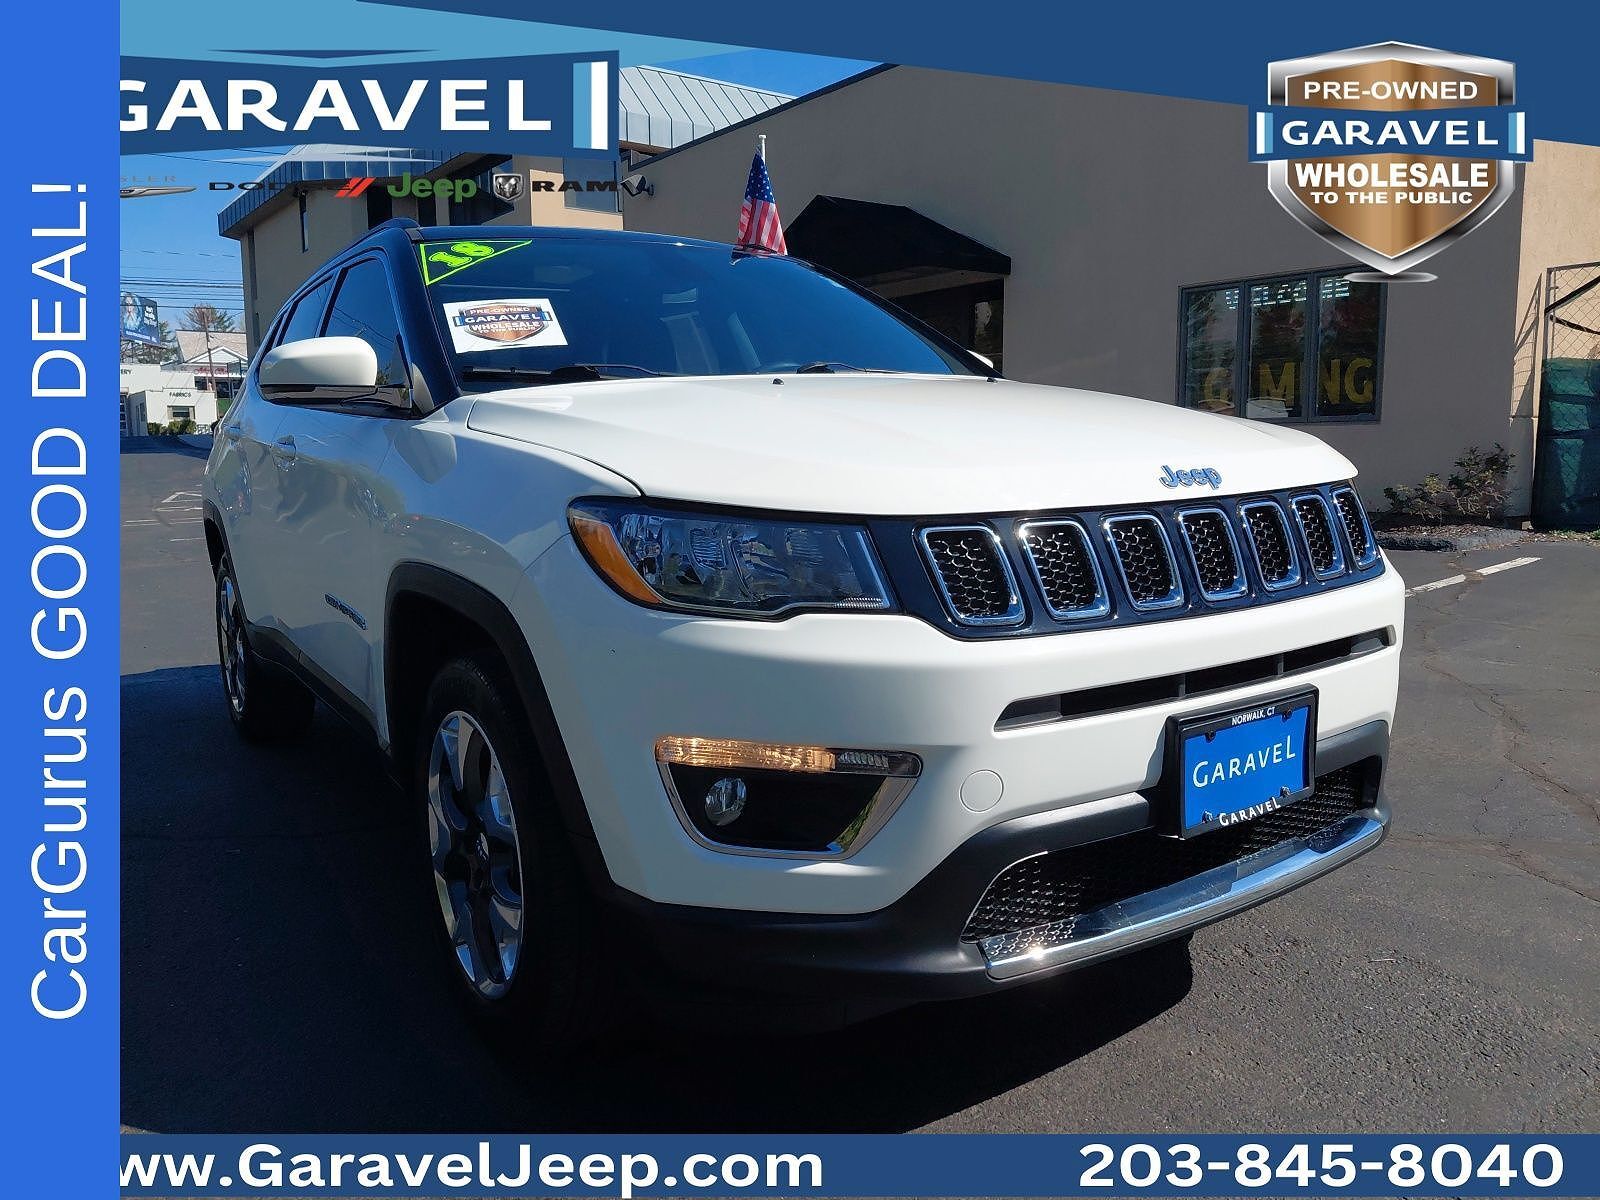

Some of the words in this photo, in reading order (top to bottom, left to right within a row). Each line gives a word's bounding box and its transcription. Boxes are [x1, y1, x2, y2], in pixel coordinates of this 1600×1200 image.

[464, 313, 541, 323] GARAVEL
[472, 321, 541, 331] WHOLESALE
[1160, 465, 1222, 490] Jeep
[1231, 708, 1266, 726] NORWALK,
[1266, 706, 1276, 717] CT
[1192, 735, 1297, 788] GARAVEL
[1219, 796, 1281, 826] GARAVEL
